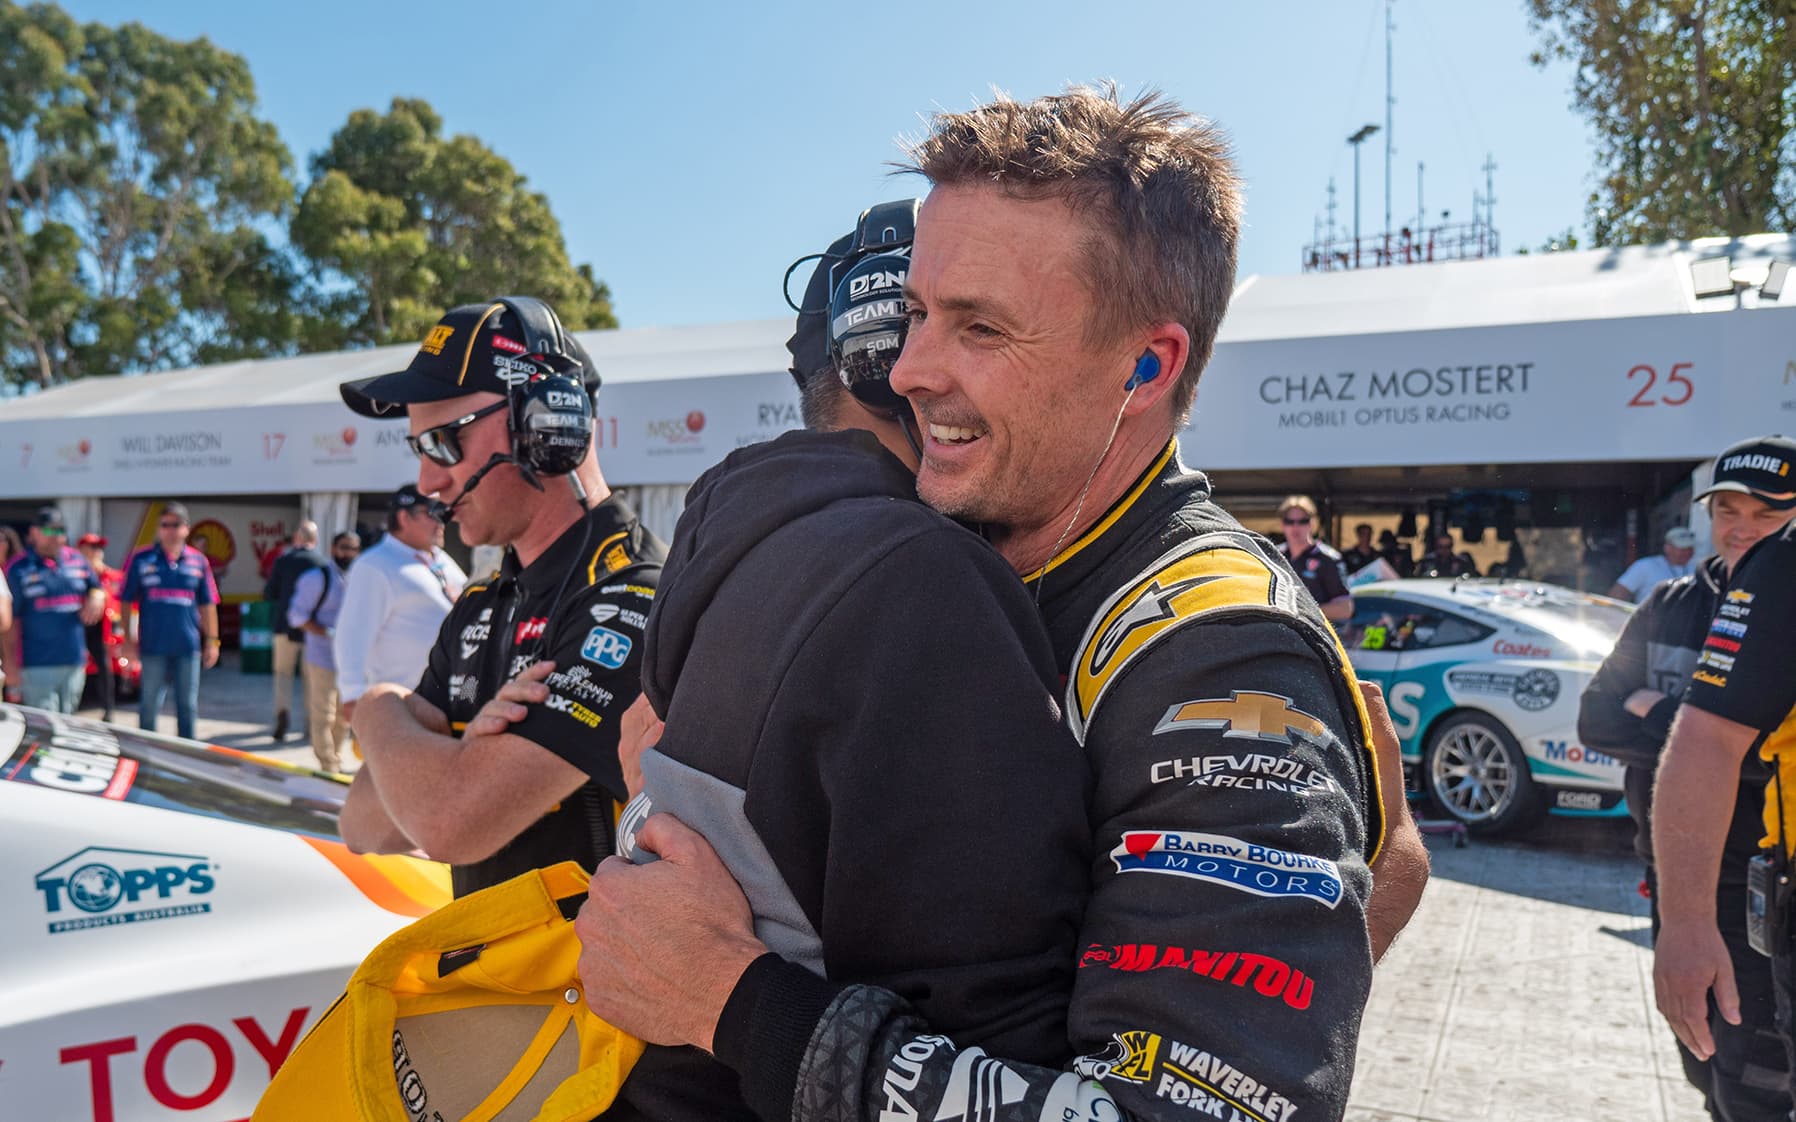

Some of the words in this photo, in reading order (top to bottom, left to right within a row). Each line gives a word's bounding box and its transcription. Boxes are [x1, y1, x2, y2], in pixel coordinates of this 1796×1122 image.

[850, 270, 905, 297] D2N
[845, 301, 895, 326] TEAM
[493, 355, 538, 375] SEIKO
[1258, 371, 1356, 404] CHAZ
[1366, 362, 1535, 399] MOSTERT
[1626, 362, 1694, 407] 25
[547, 391, 582, 408] D2N
[544, 415, 578, 427] TEAM
[757, 402, 801, 426] RYA
[1277, 408, 1348, 428] MOBIL1
[1354, 405, 1419, 426] OPTUS
[1425, 402, 1512, 422] RACING
[121, 436, 152, 455] WILL
[155, 430, 222, 453] DAVISON
[375, 428, 409, 447] ANT
[595, 416, 618, 448] 11
[263, 431, 286, 461] 17
[1722, 453, 1781, 474] TRADIE
[586, 632, 628, 663] PPG
[1362, 625, 1387, 650] 25
[1492, 639, 1552, 657] Coates
[571, 710, 599, 728] AUTO
[1151, 754, 1336, 793] CHEVROLET
[1187, 775, 1310, 796] RACING
[1163, 833, 1242, 857] BARRY
[36, 862, 216, 914] TOPPS
[1165, 855, 1338, 898] MOTORS
[54, 913, 128, 932] PRODUCTS
[133, 904, 206, 922] AUSTRALIA
[1110, 943, 1315, 1010] MANITOU
[1169, 1040, 1298, 1122] WAVERLEY
[1156, 1073, 1226, 1119] FORK
